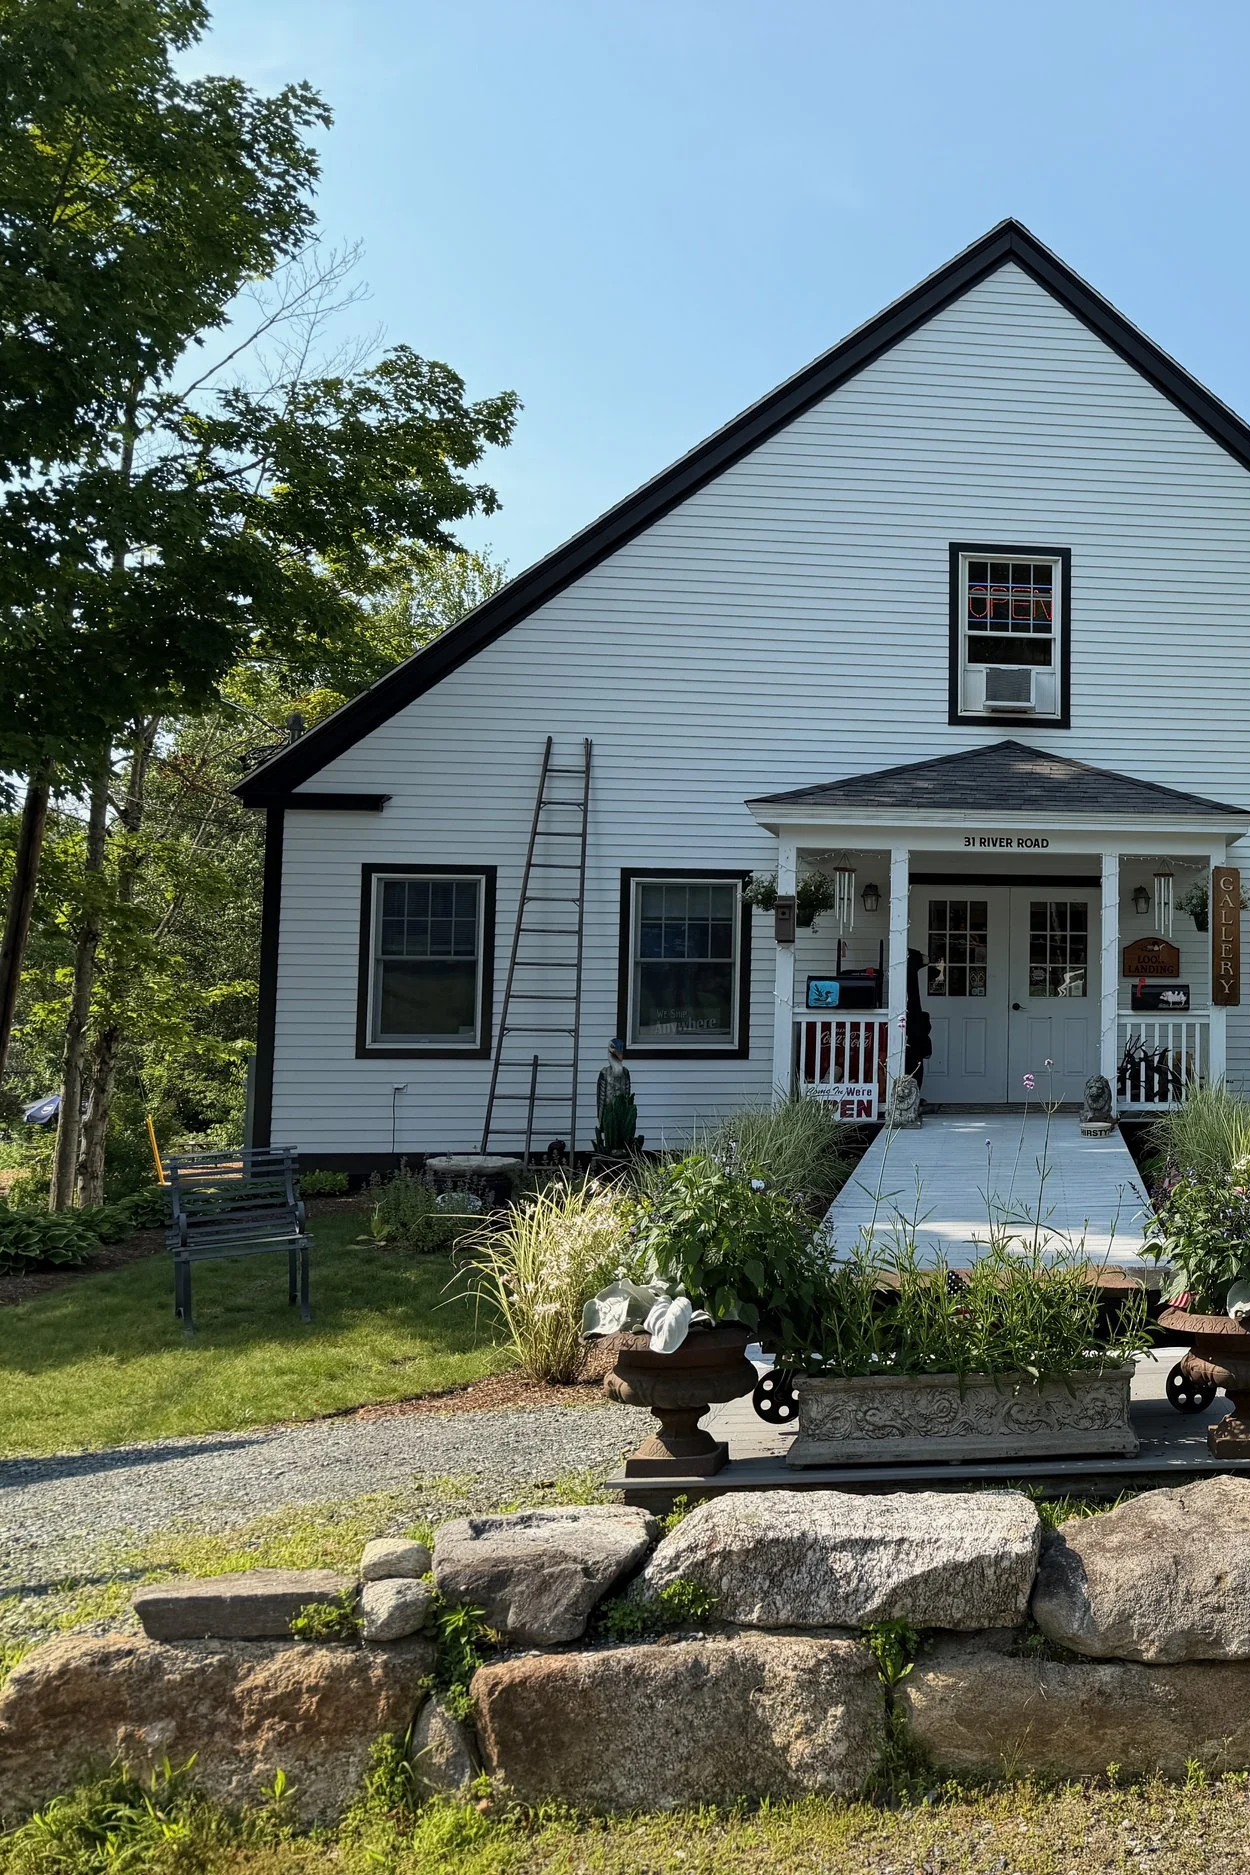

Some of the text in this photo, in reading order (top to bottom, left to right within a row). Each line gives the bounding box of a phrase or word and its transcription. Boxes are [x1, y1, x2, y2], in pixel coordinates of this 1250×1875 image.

[969, 586, 1053, 621] OPEN
[963, 836, 1050, 849] 31 RIVER ROAD
[1219, 876, 1236, 994] GALLERY
[1128, 965, 1174, 975] LANDING
[655, 1016, 717, 1034] Anywhere
[806, 1086, 873, 1097] Come In We're
[812, 1099, 873, 1118] PEN
